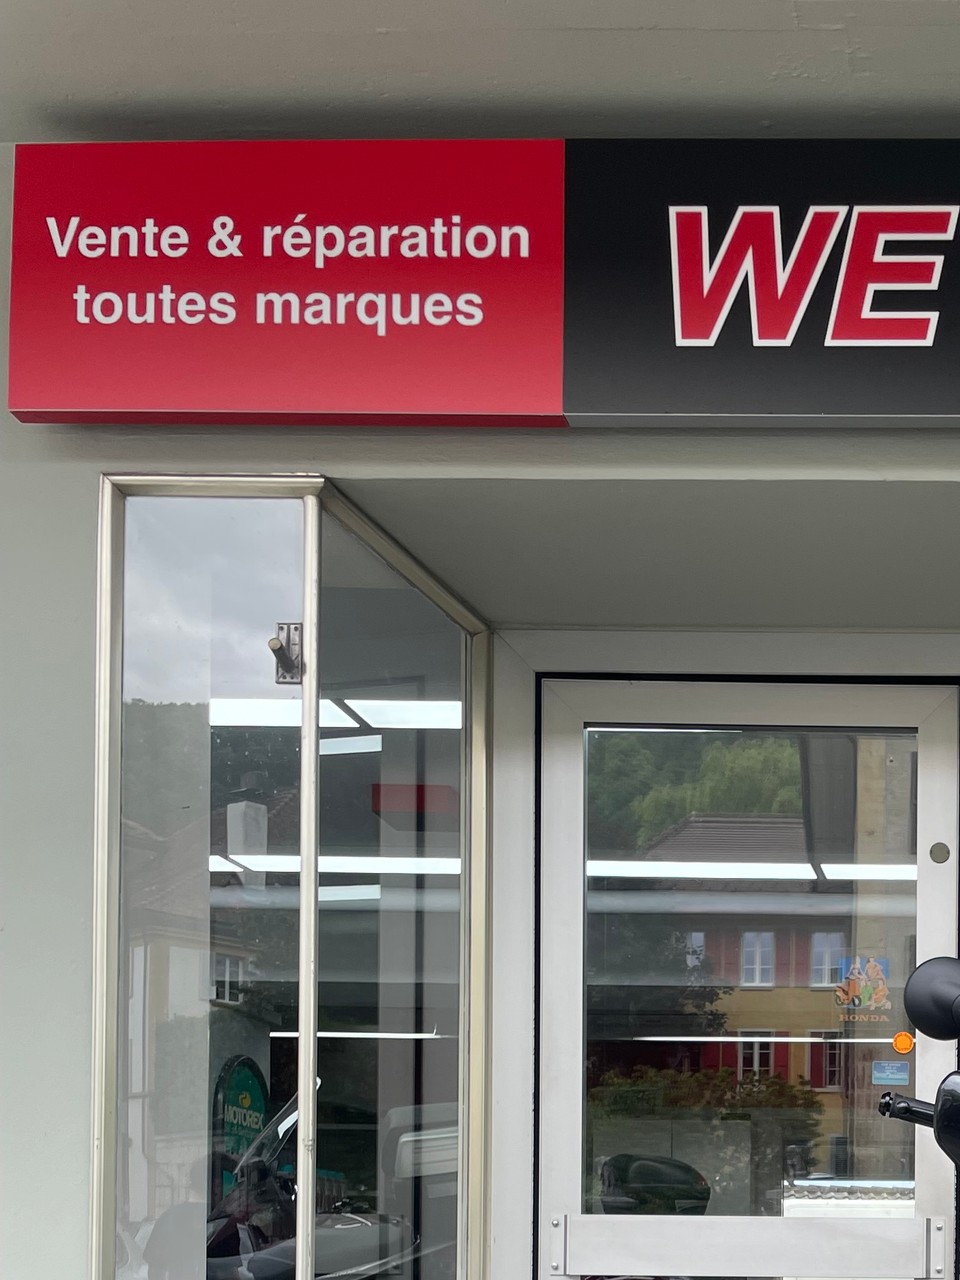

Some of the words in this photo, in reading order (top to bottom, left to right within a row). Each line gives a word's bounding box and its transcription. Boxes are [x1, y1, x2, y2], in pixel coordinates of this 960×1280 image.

[46, 216, 190, 259] Vente
[206, 215, 244, 258] &
[262, 213, 531, 268] réparation
[73, 284, 237, 325] toutes
[254, 291, 485, 337] marques
[224, 1104, 264, 1129] MOTOREX
